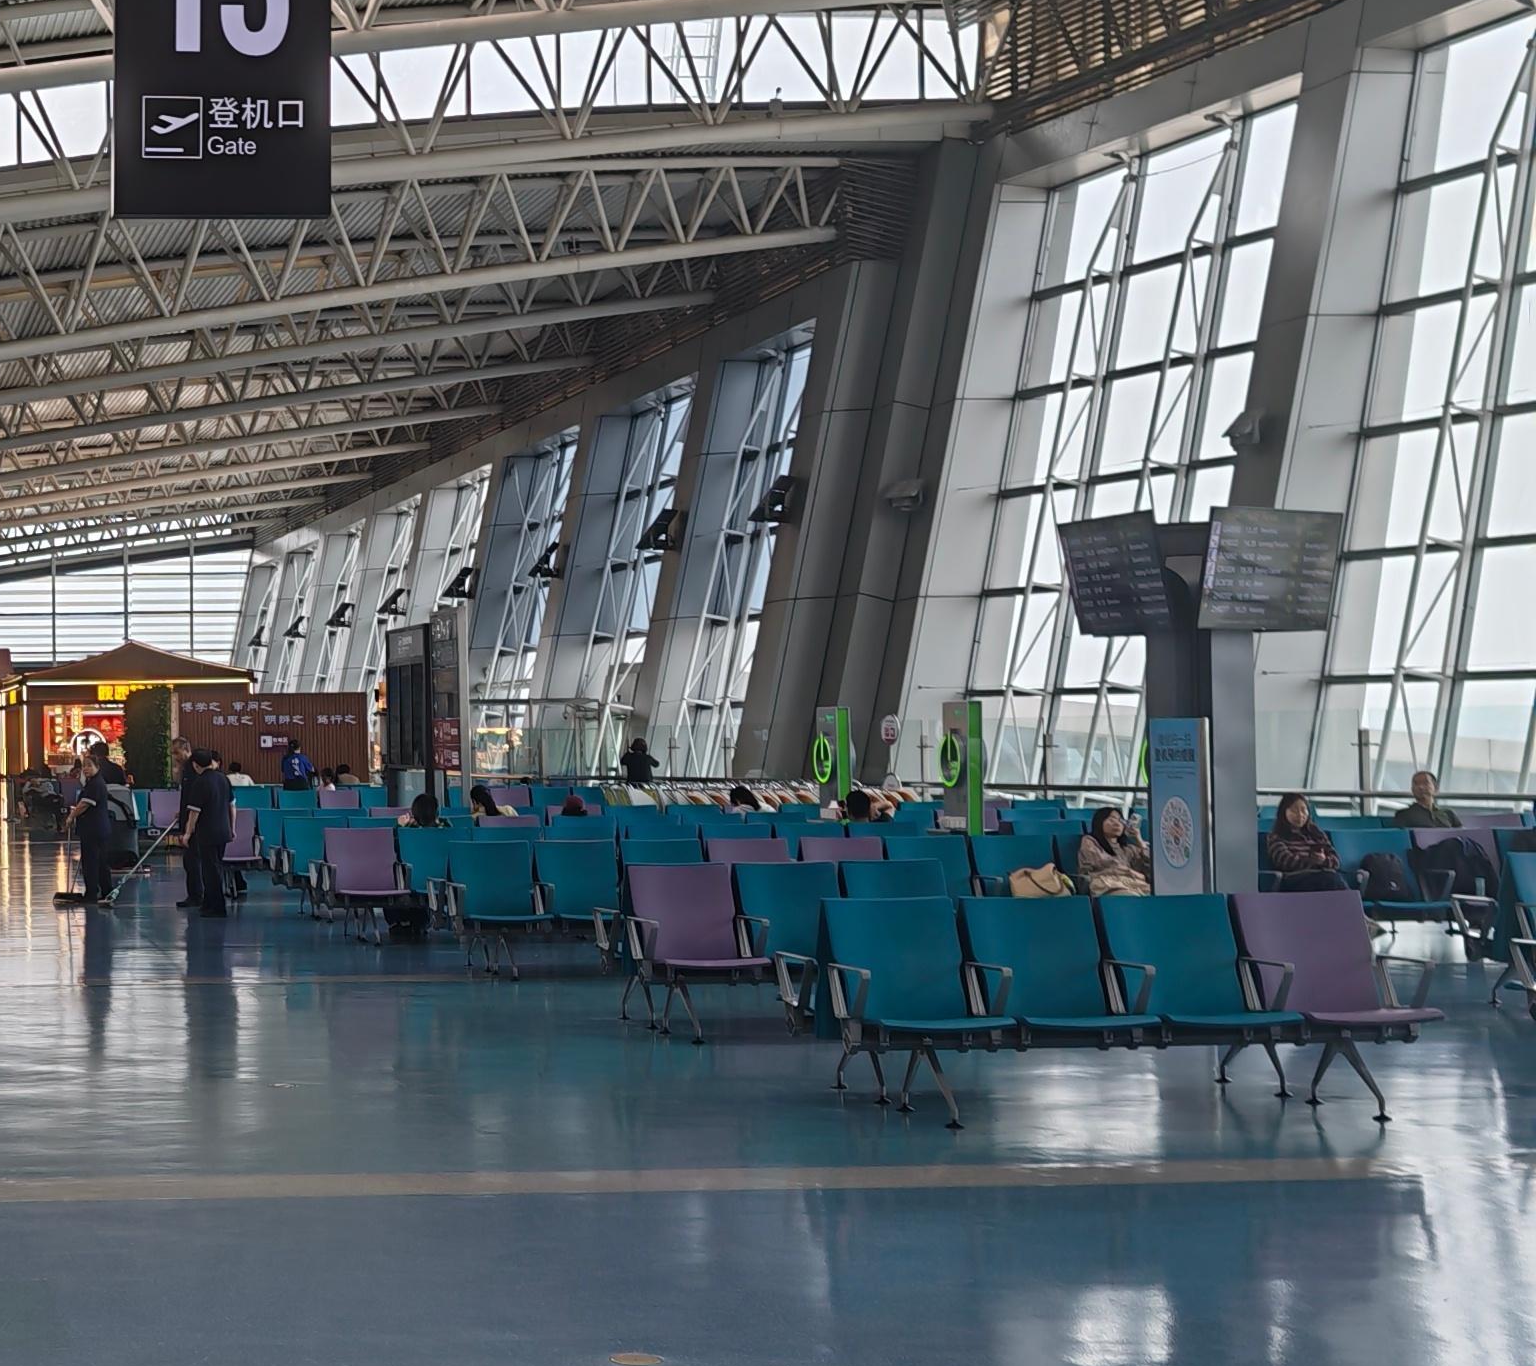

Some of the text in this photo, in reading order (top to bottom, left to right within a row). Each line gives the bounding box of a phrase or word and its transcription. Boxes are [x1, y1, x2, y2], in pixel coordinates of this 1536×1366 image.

[208, 97, 305, 130] 登机口
[207, 137, 257, 156] Gate
